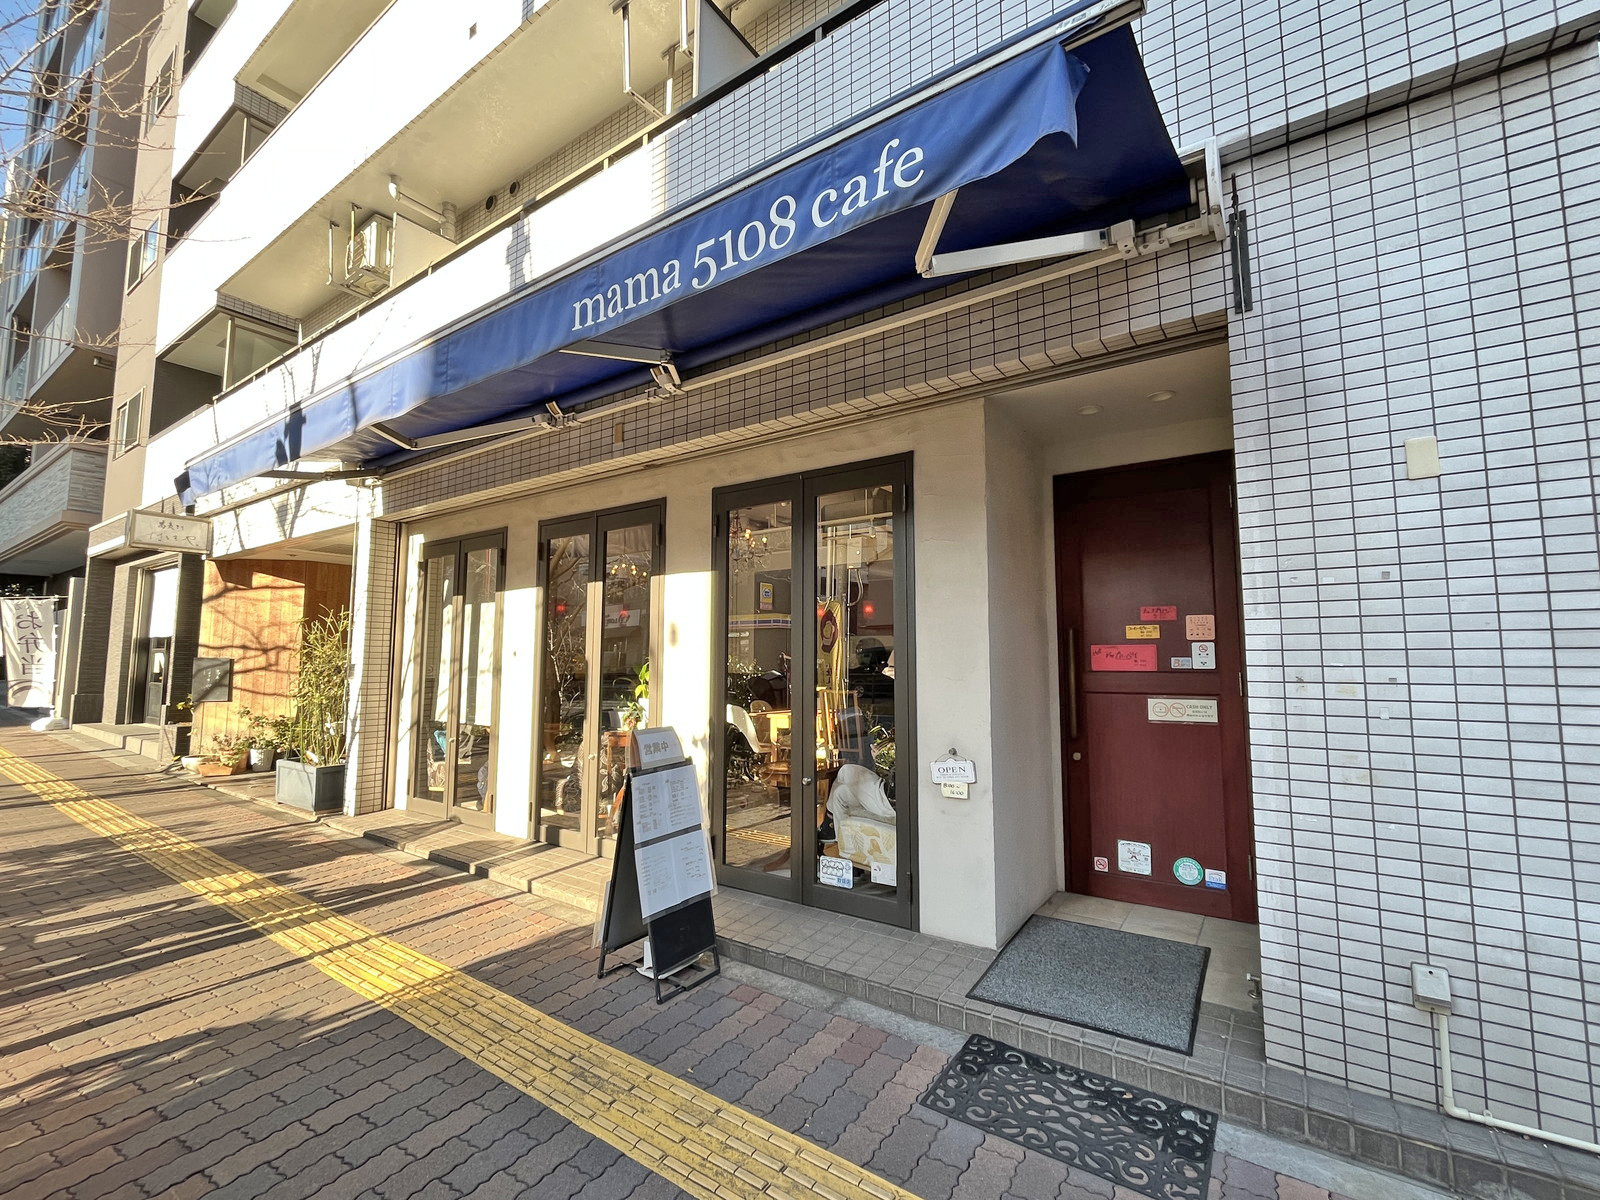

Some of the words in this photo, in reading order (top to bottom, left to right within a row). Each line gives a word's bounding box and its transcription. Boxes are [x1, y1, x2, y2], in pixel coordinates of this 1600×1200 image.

[572, 259, 681, 332] mama
[691, 194, 797, 291] 5108
[811, 137, 925, 228] cafe
[643, 740, 669, 756] 営業中
[937, 766, 966, 774] OPEN
